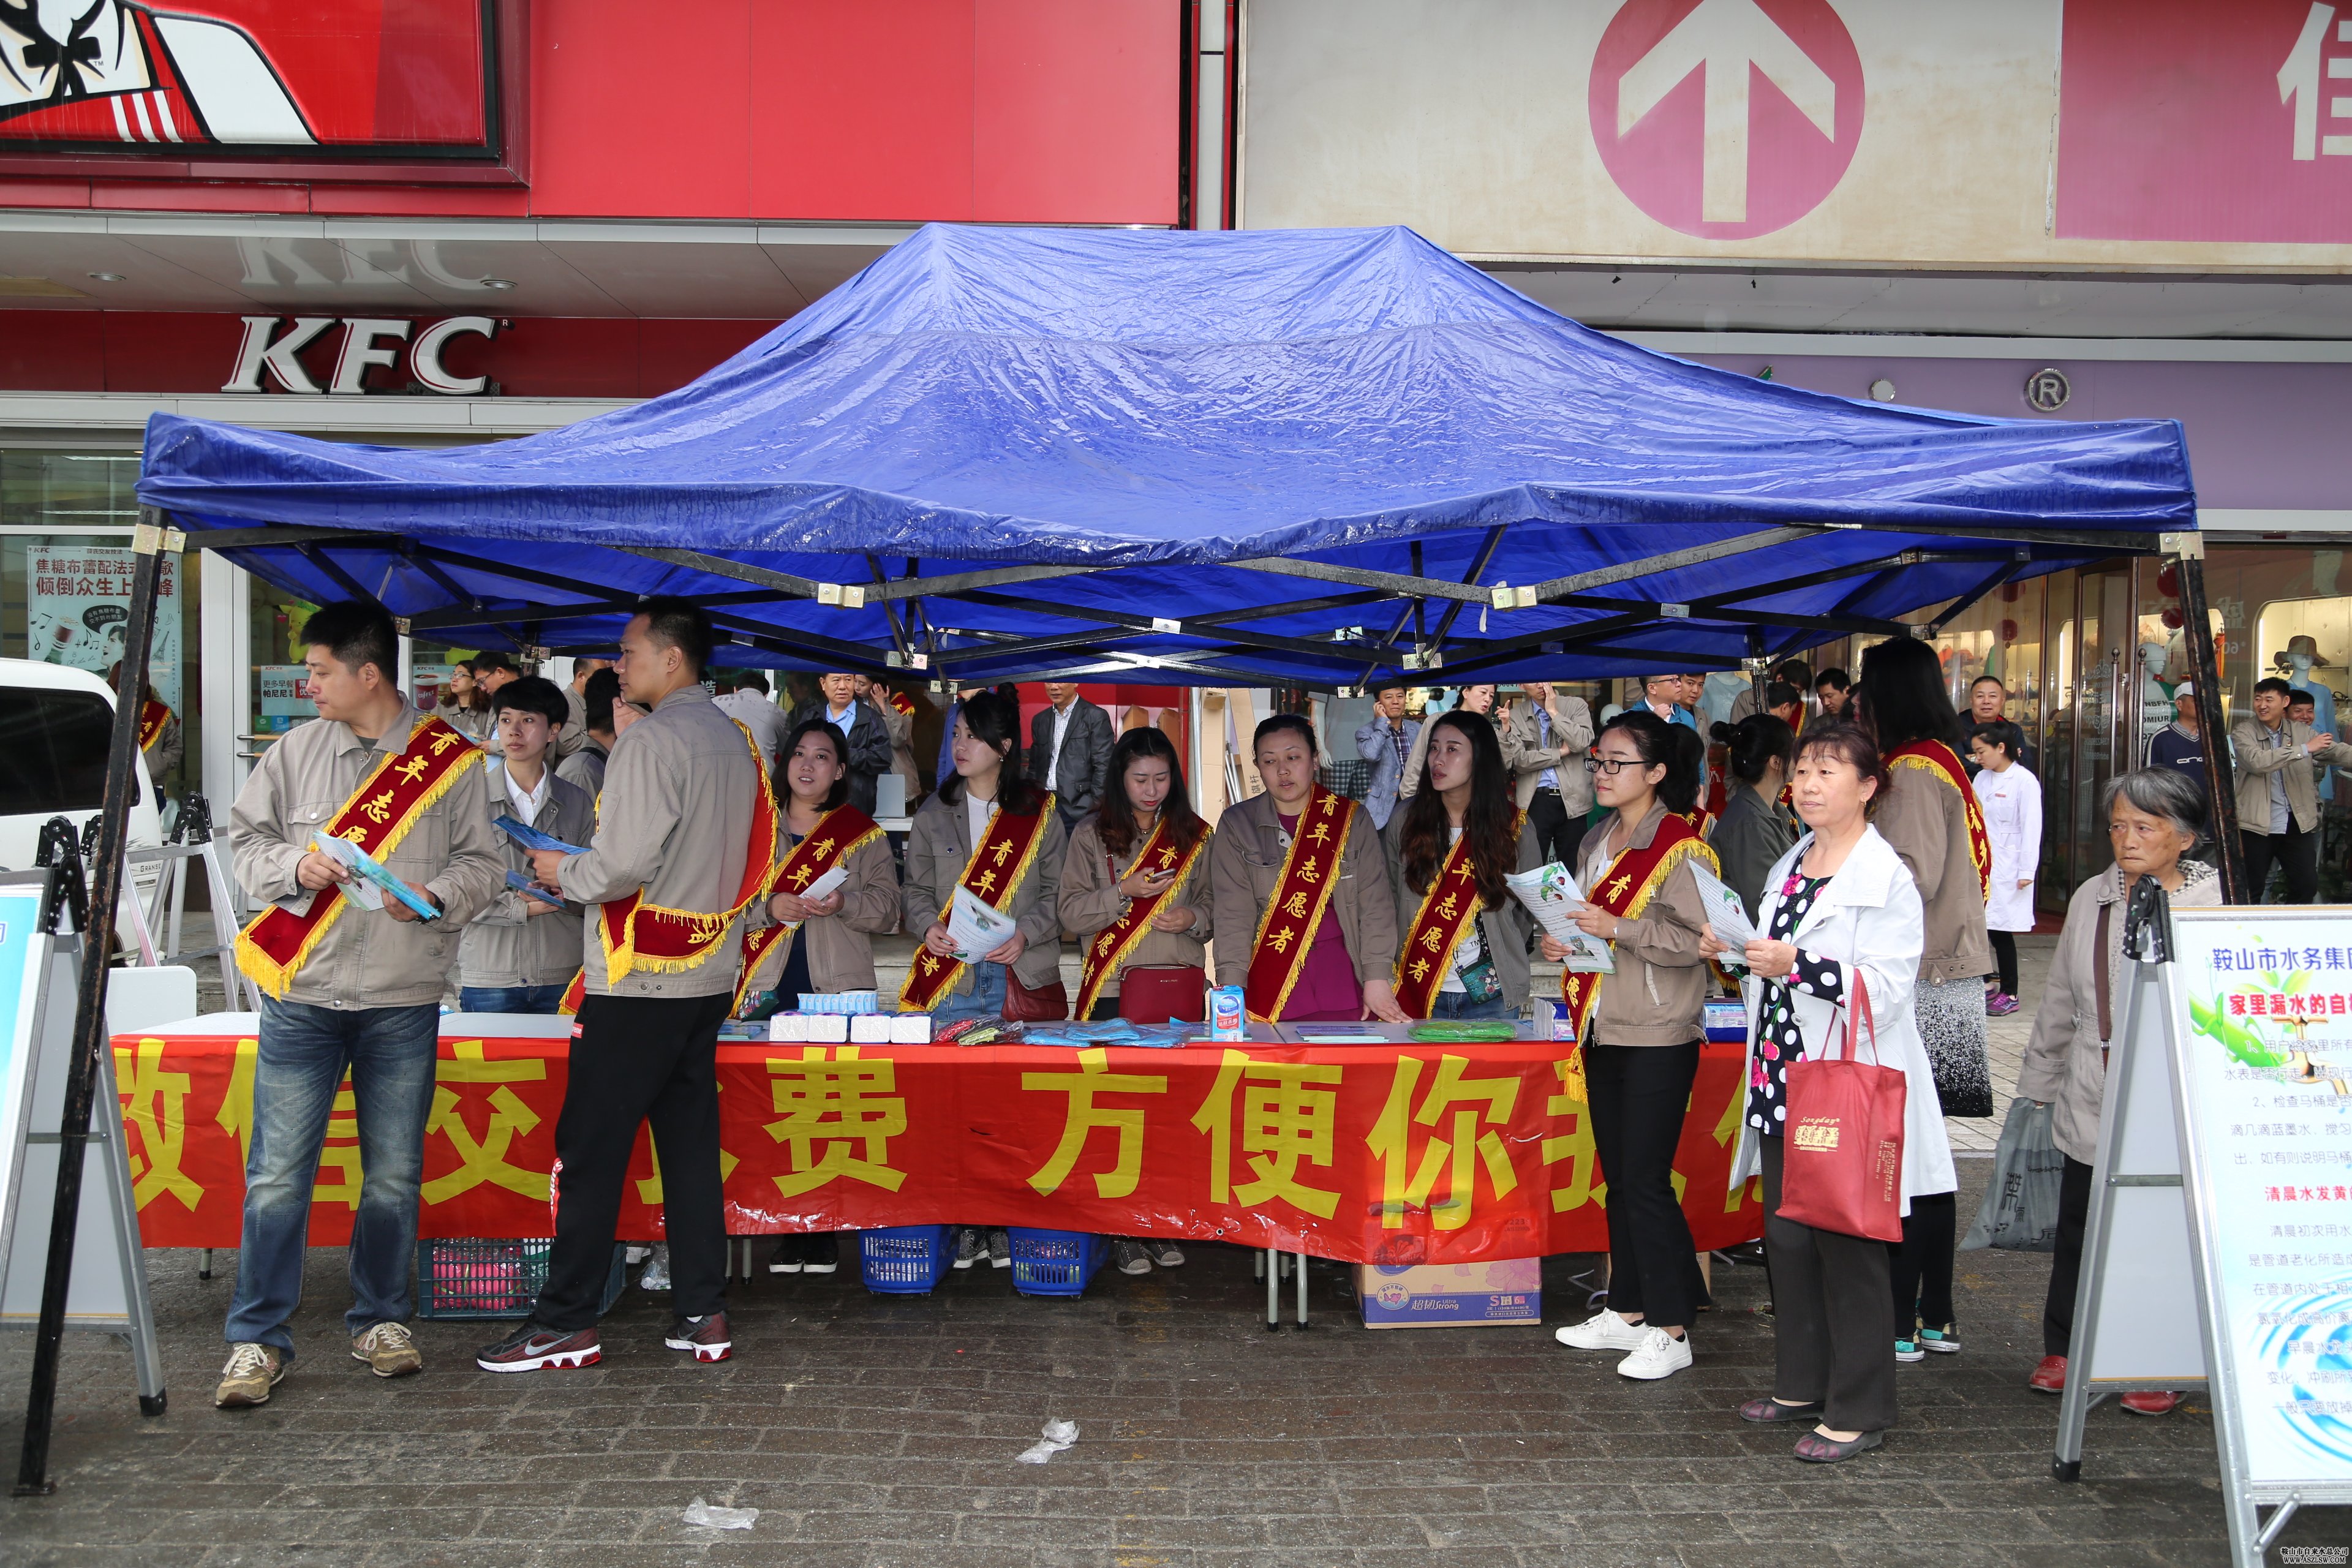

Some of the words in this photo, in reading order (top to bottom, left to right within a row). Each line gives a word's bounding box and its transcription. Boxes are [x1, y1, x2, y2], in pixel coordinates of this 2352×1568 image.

[221, 315, 496, 395] KFC
[36, 559, 173, 575] 焦糖布蕾配法歌
[36, 576, 173, 597] 倾倒众生上峰
[263, 680, 294, 688] 更多早餐
[1266, 793, 1339, 954] 青年志愿者
[2212, 947, 2352, 971] 鞍山市水务集
[2229, 993, 2352, 1016] 家里漏水的自
[2265, 1185, 2352, 1202] 清晨水发黄
[2253, 1282, 2352, 1295] 在管道内处于相
[2257, 1312, 2352, 1325] 氯氧化成高价离
